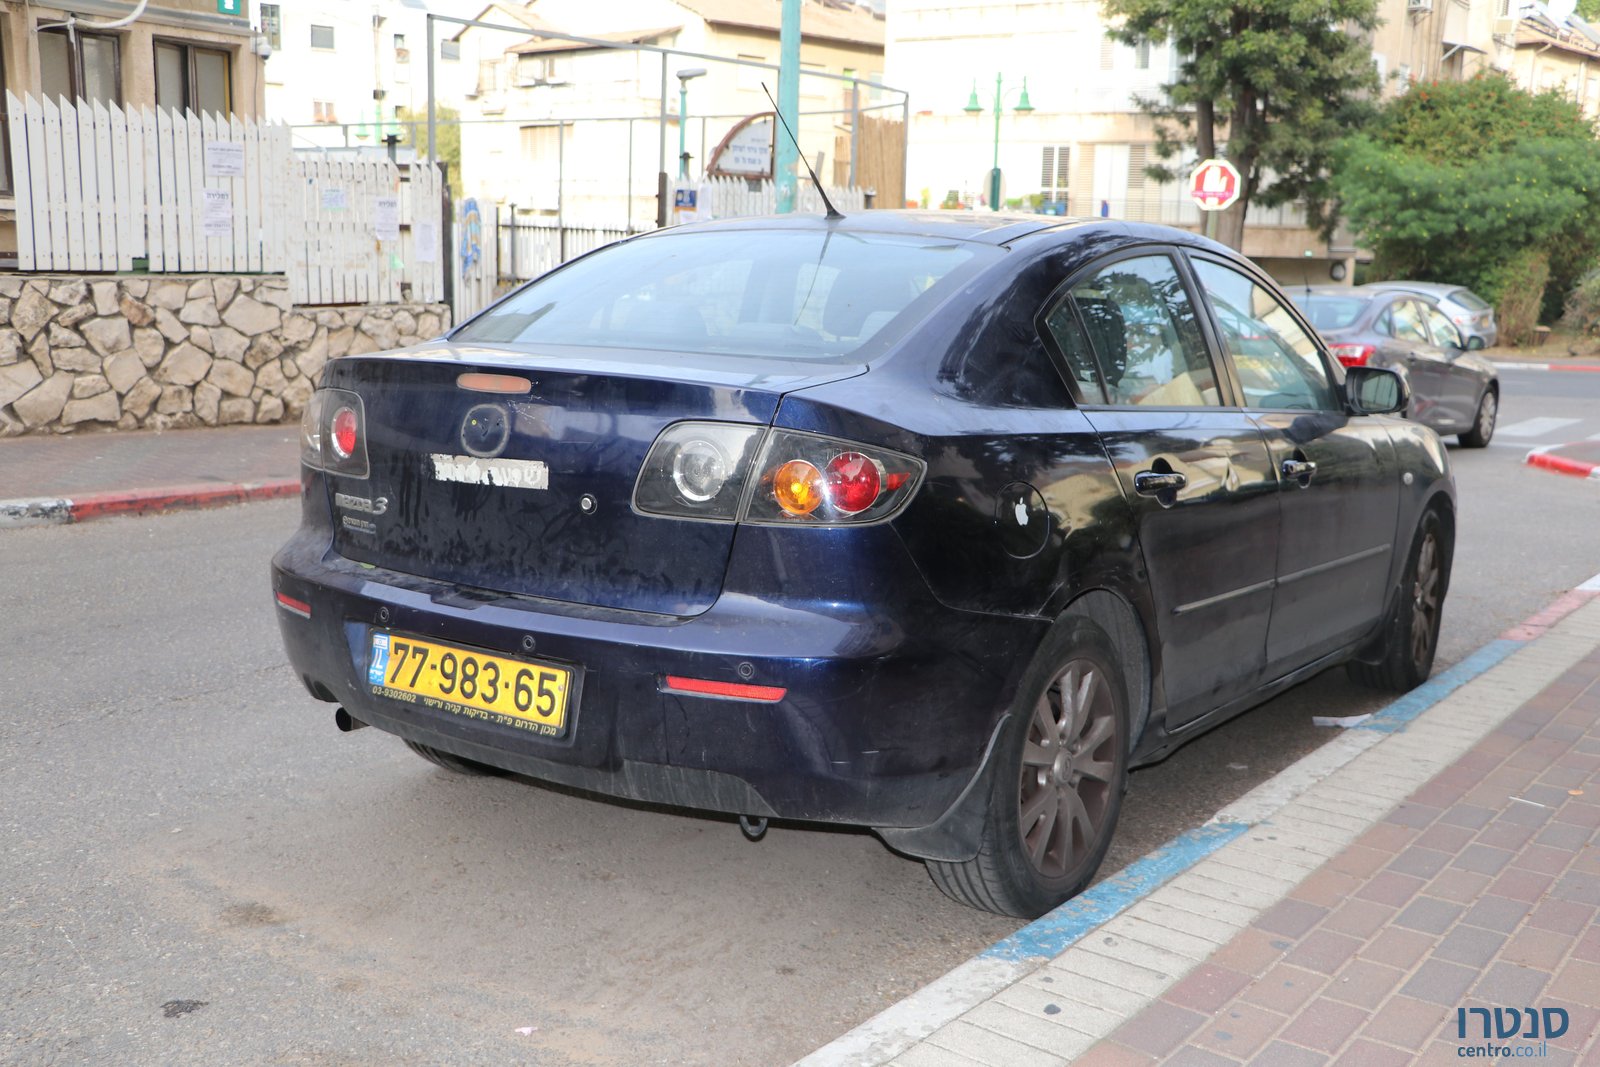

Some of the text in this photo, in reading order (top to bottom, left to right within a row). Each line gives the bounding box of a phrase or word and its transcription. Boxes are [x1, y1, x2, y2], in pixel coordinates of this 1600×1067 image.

[372, 496, 388, 515] 3
[424, 696, 443, 709] ורישוי
[445, 702, 461, 714] קניה
[463, 707, 488, 719] בדיקות
[515, 719, 539, 731] הדרום
[540, 725, 557, 735] מכון
